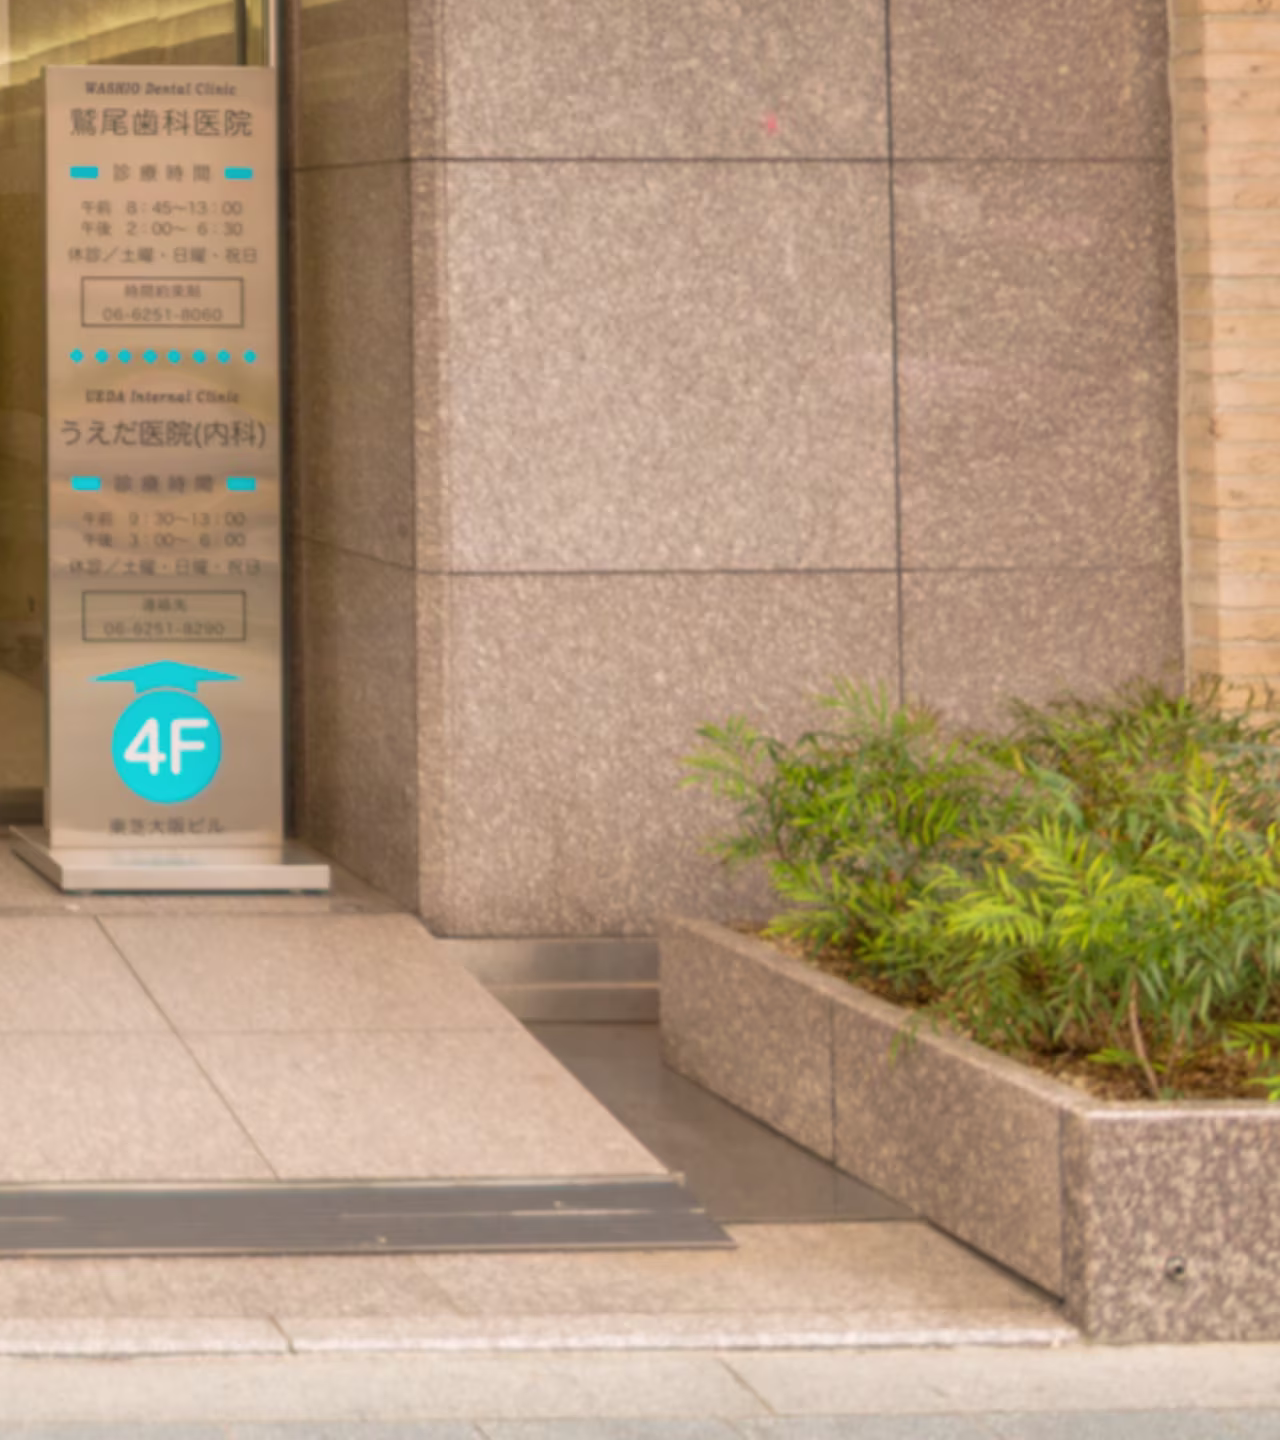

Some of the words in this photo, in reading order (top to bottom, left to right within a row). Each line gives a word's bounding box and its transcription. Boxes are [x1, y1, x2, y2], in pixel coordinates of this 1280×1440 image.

[144, 82, 191, 97] Dental
[195, 82, 237, 97] Clinic
[70, 108, 254, 137] 鷲尾歯科医院
[129, 389, 191, 404] Internal
[196, 390, 240, 405] Clinic
[60, 420, 268, 449] うえだ医院(内科)
[123, 717, 210, 776] 4F
